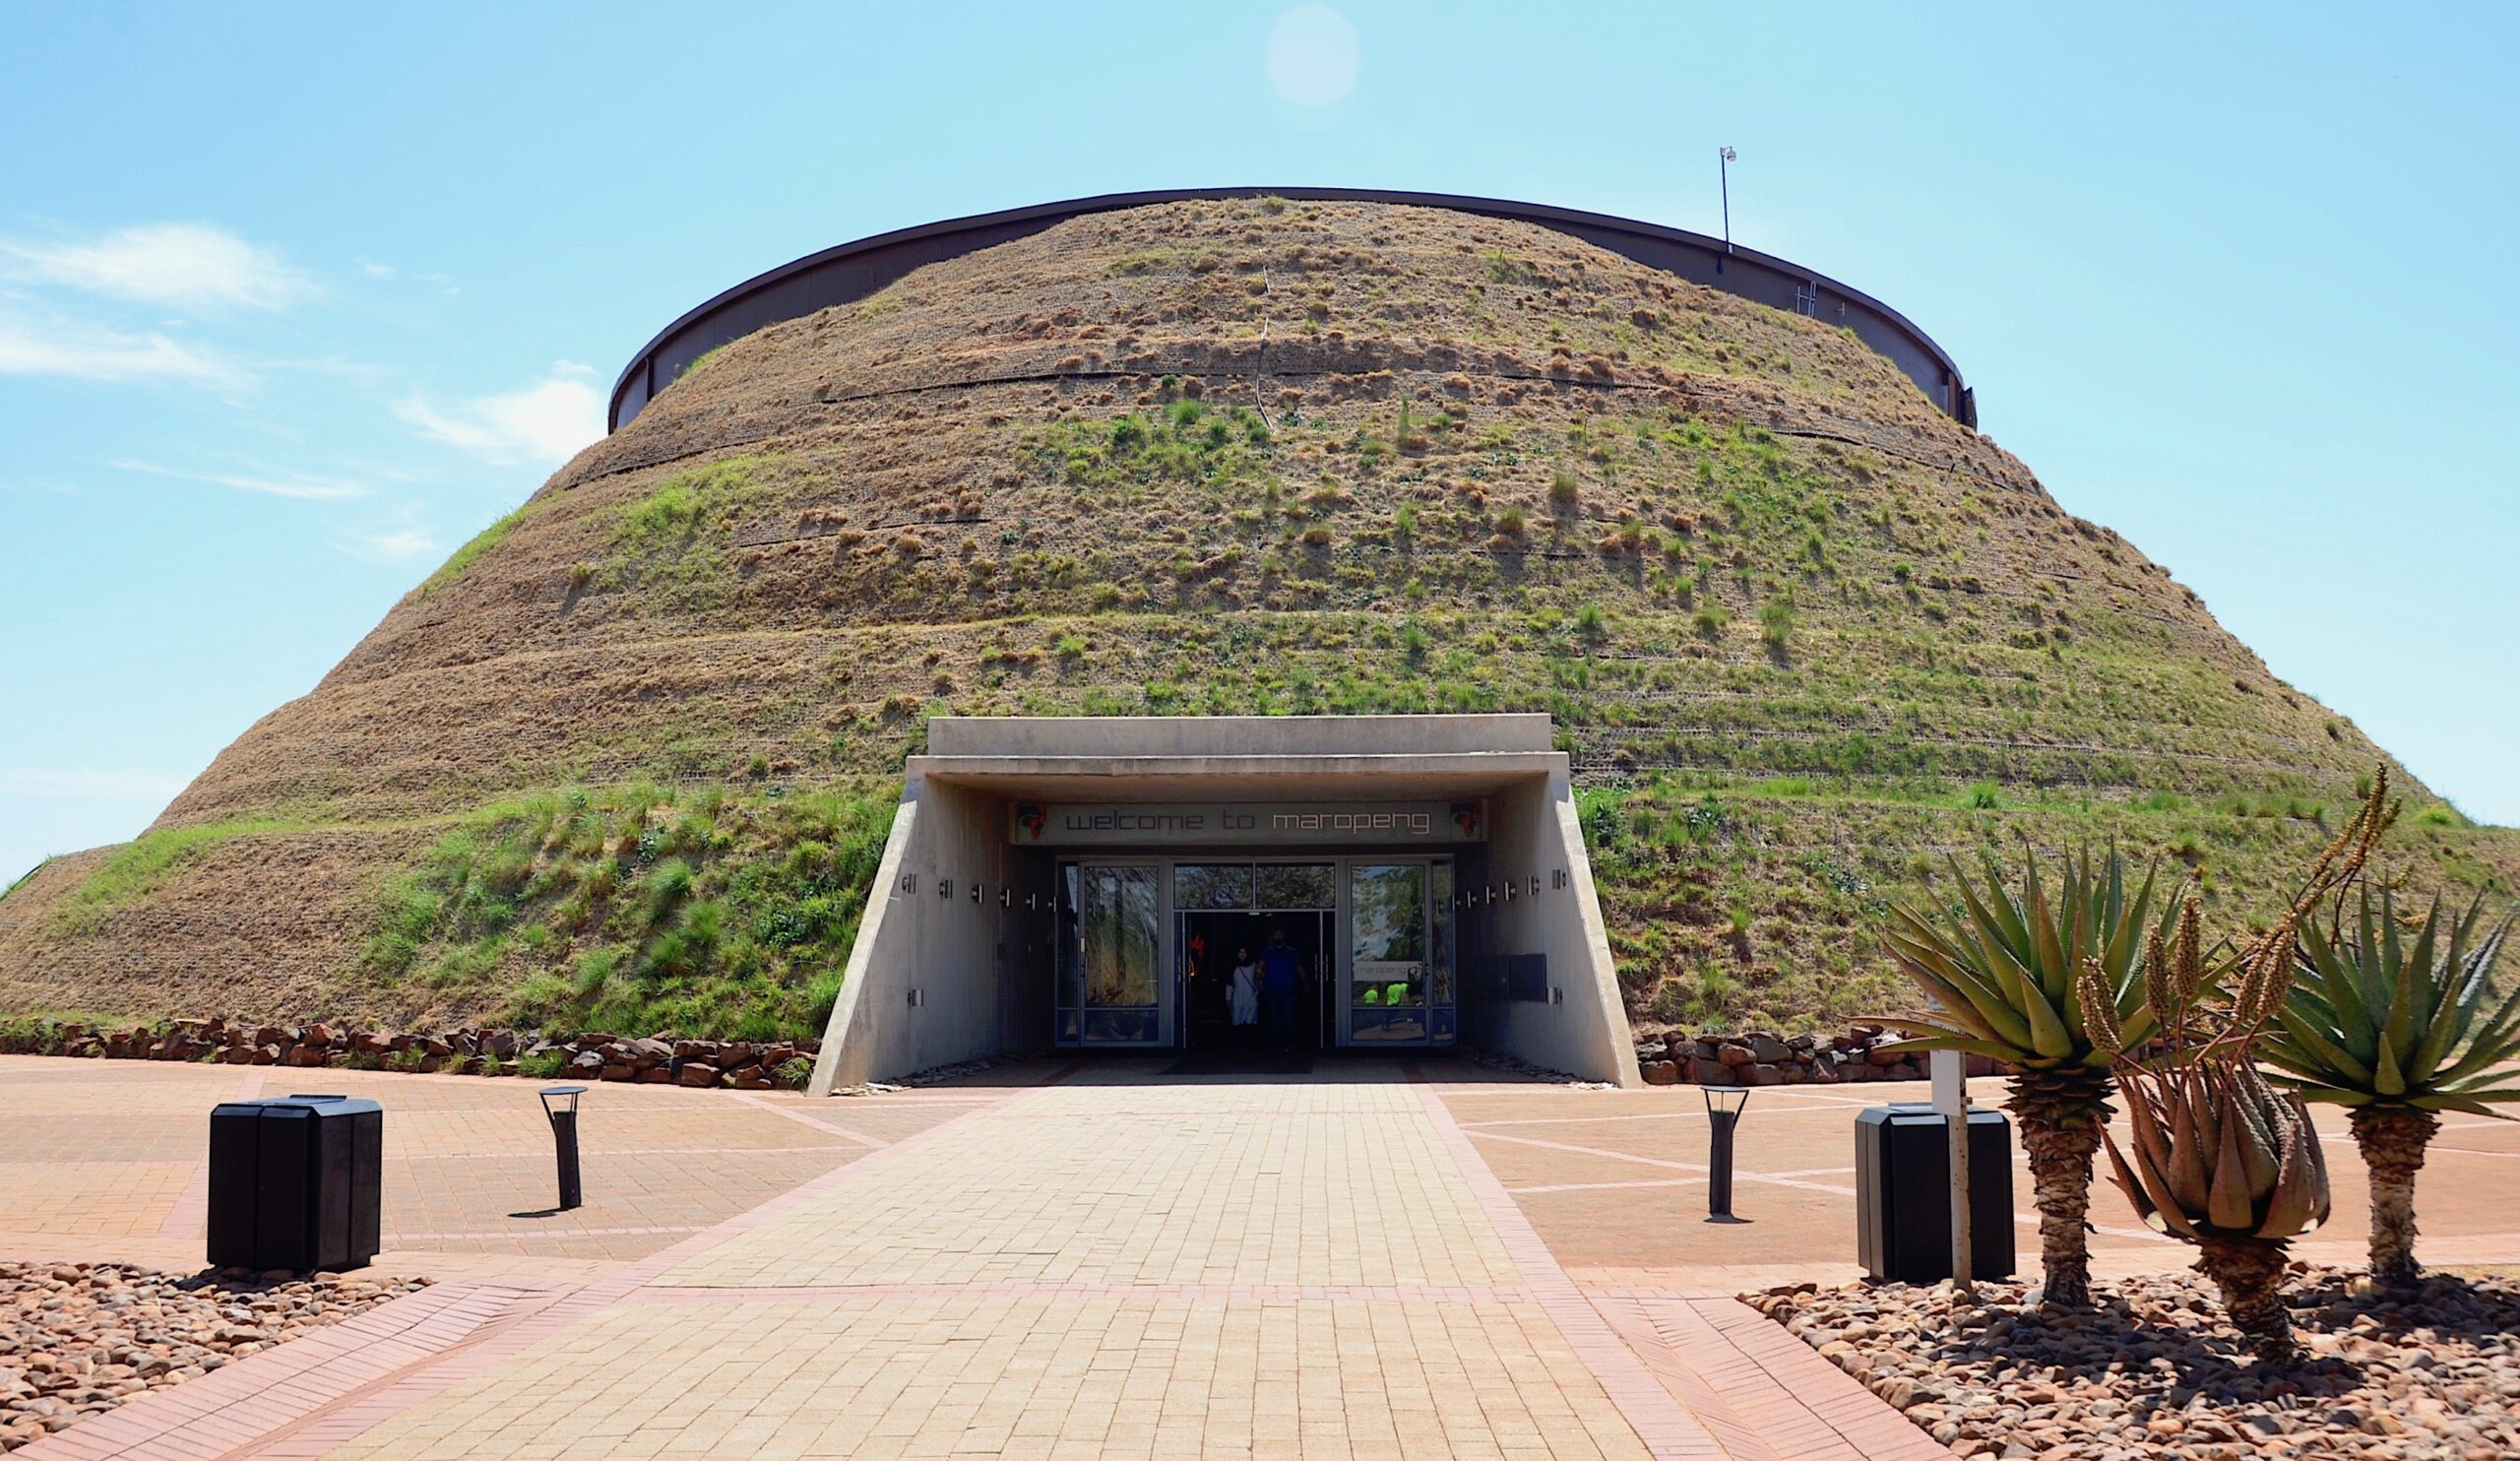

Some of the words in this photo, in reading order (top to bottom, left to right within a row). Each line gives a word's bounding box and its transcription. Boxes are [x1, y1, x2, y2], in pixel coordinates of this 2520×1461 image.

[1067, 809, 1204, 830] welcome
[1223, 809, 1255, 830] to
[1272, 812, 1430, 835] maropeng
